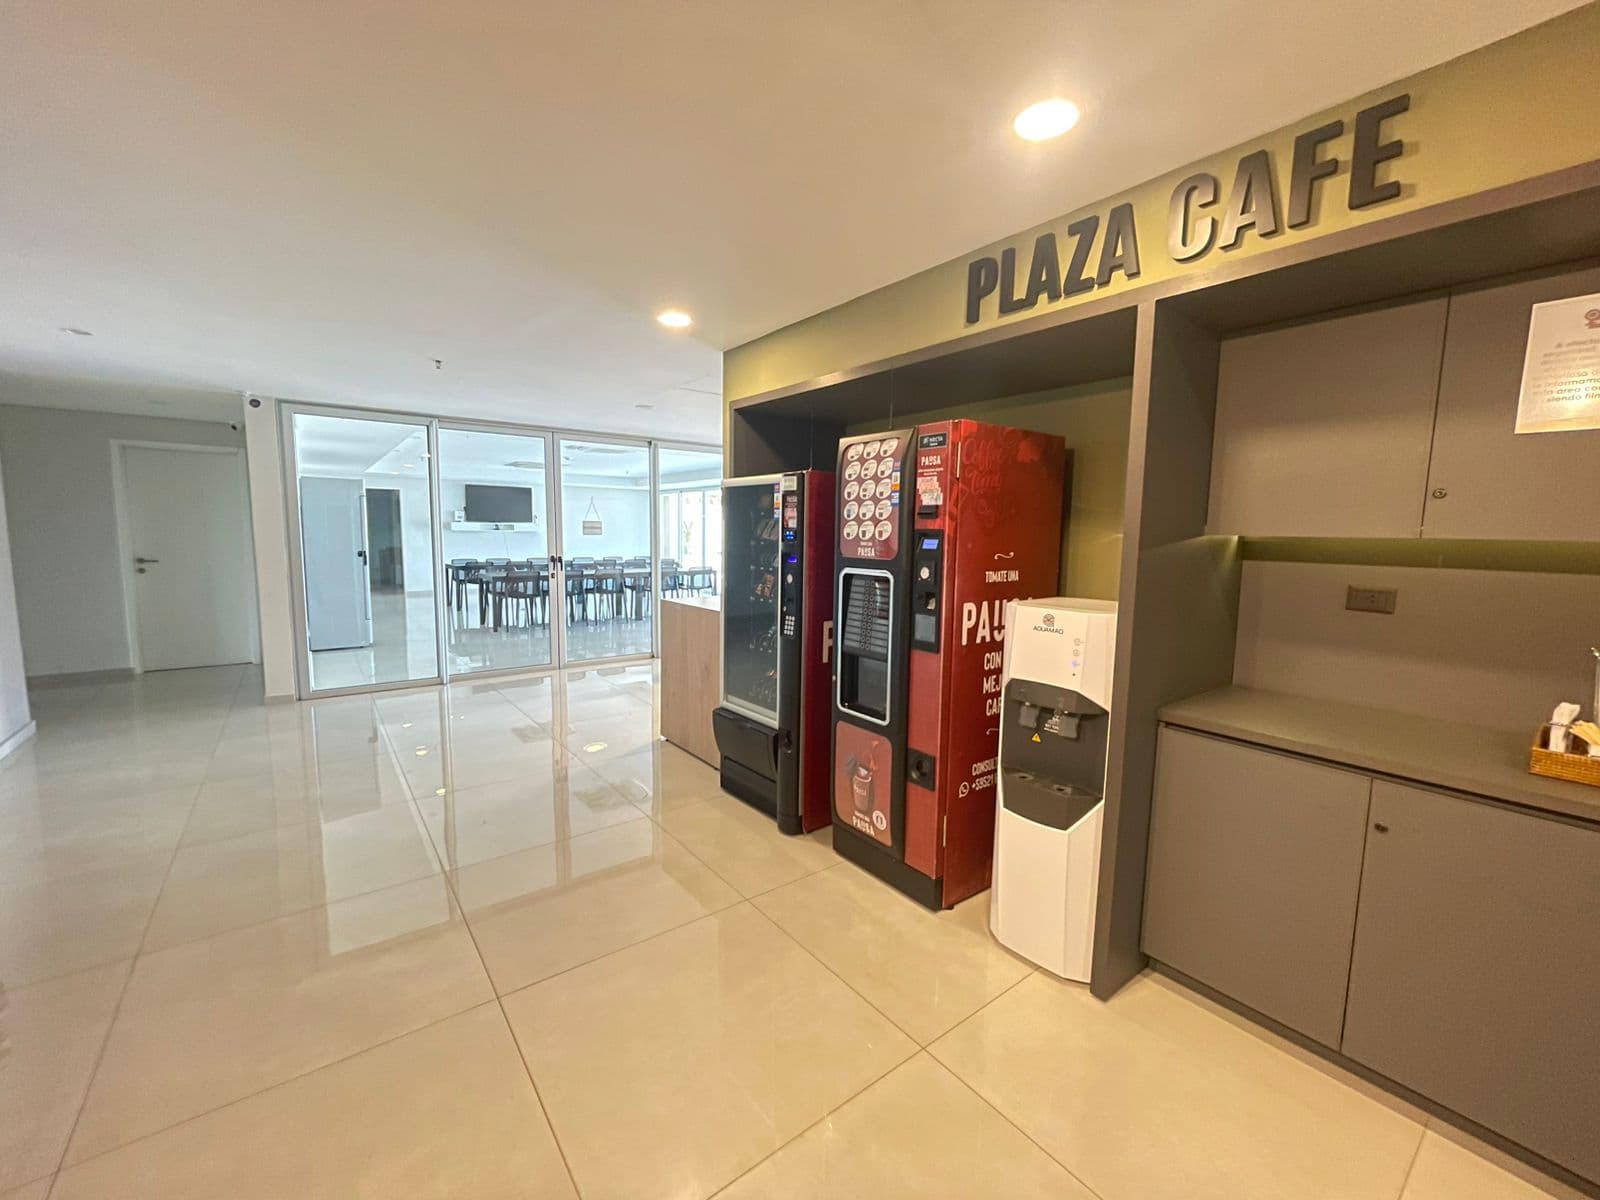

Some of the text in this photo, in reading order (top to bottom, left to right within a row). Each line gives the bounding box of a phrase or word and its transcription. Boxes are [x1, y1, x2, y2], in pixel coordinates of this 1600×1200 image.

[964, 93, 1411, 325] PLAZA CAFE
[985, 570, 1019, 583] TOMATE UNA
